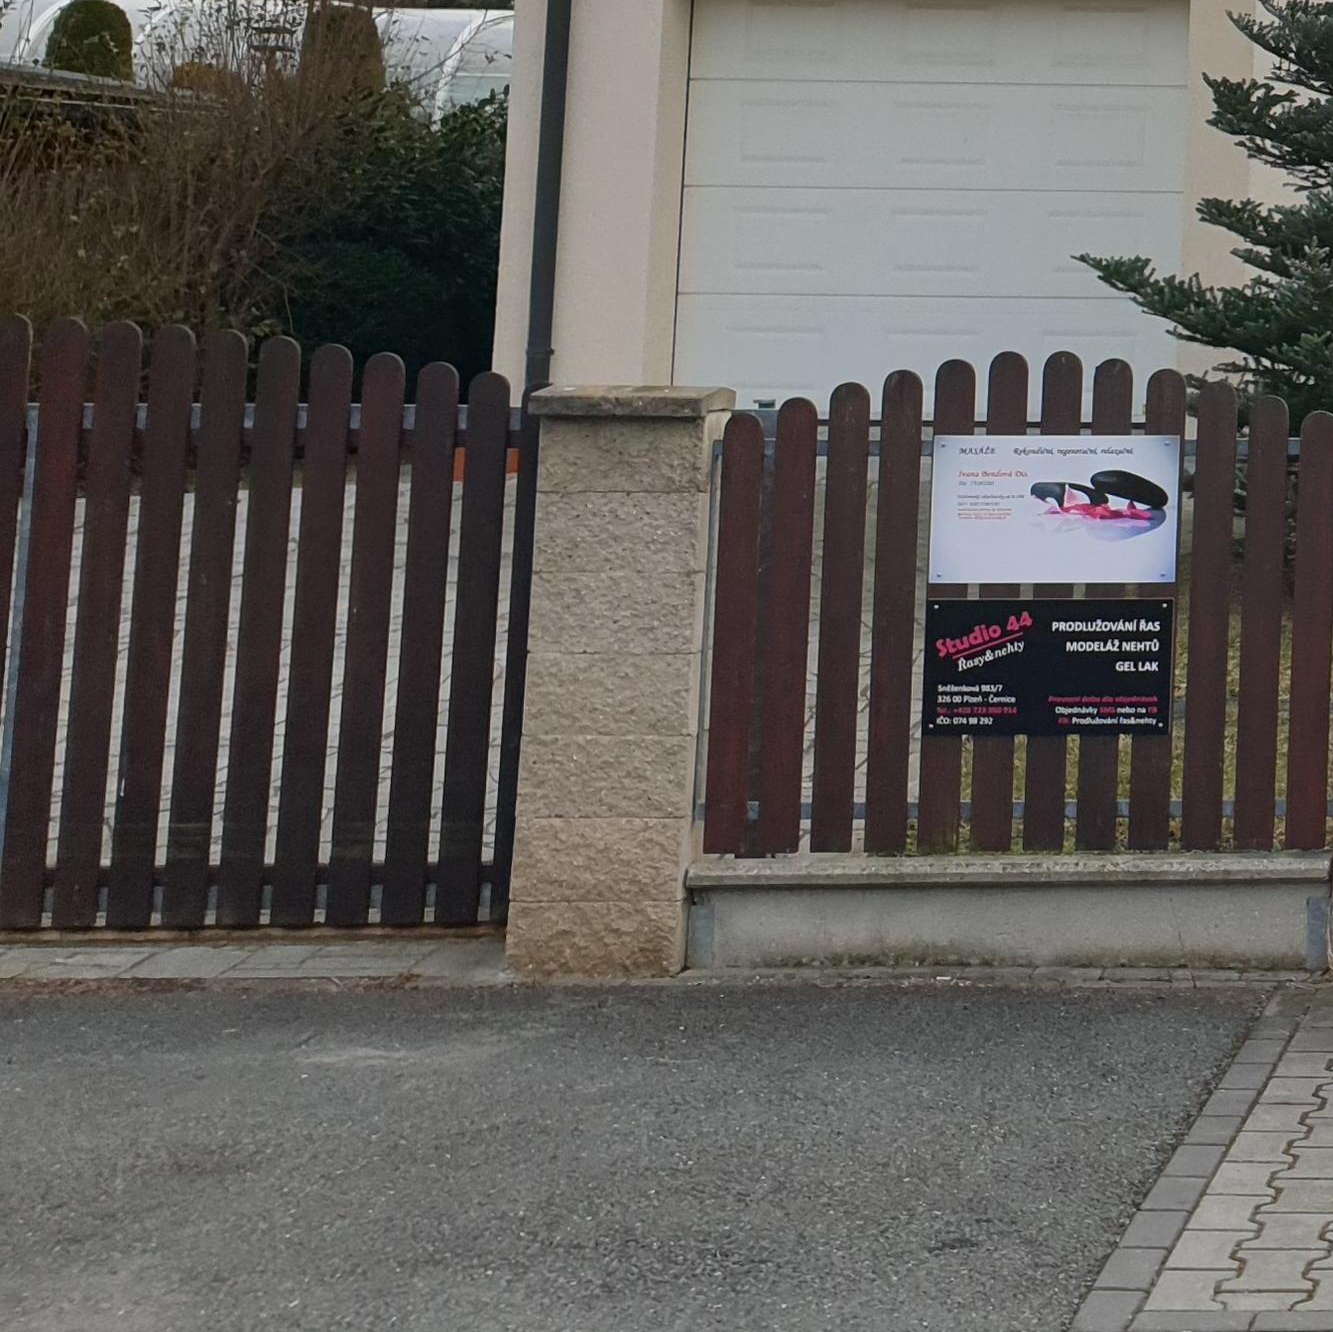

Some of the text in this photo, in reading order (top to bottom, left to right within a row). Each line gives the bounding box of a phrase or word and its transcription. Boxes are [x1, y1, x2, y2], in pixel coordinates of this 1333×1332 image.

[1052, 618, 1161, 632] PRODLUŽOVÁNÍ ŘAS
[935, 611, 1033, 658] Studio 44
[1065, 638, 1160, 652] MODELÁŽ NEHTŮ
[1115, 661, 1159, 672] GEL LAK
[1116, 706, 1136, 714] nebo
